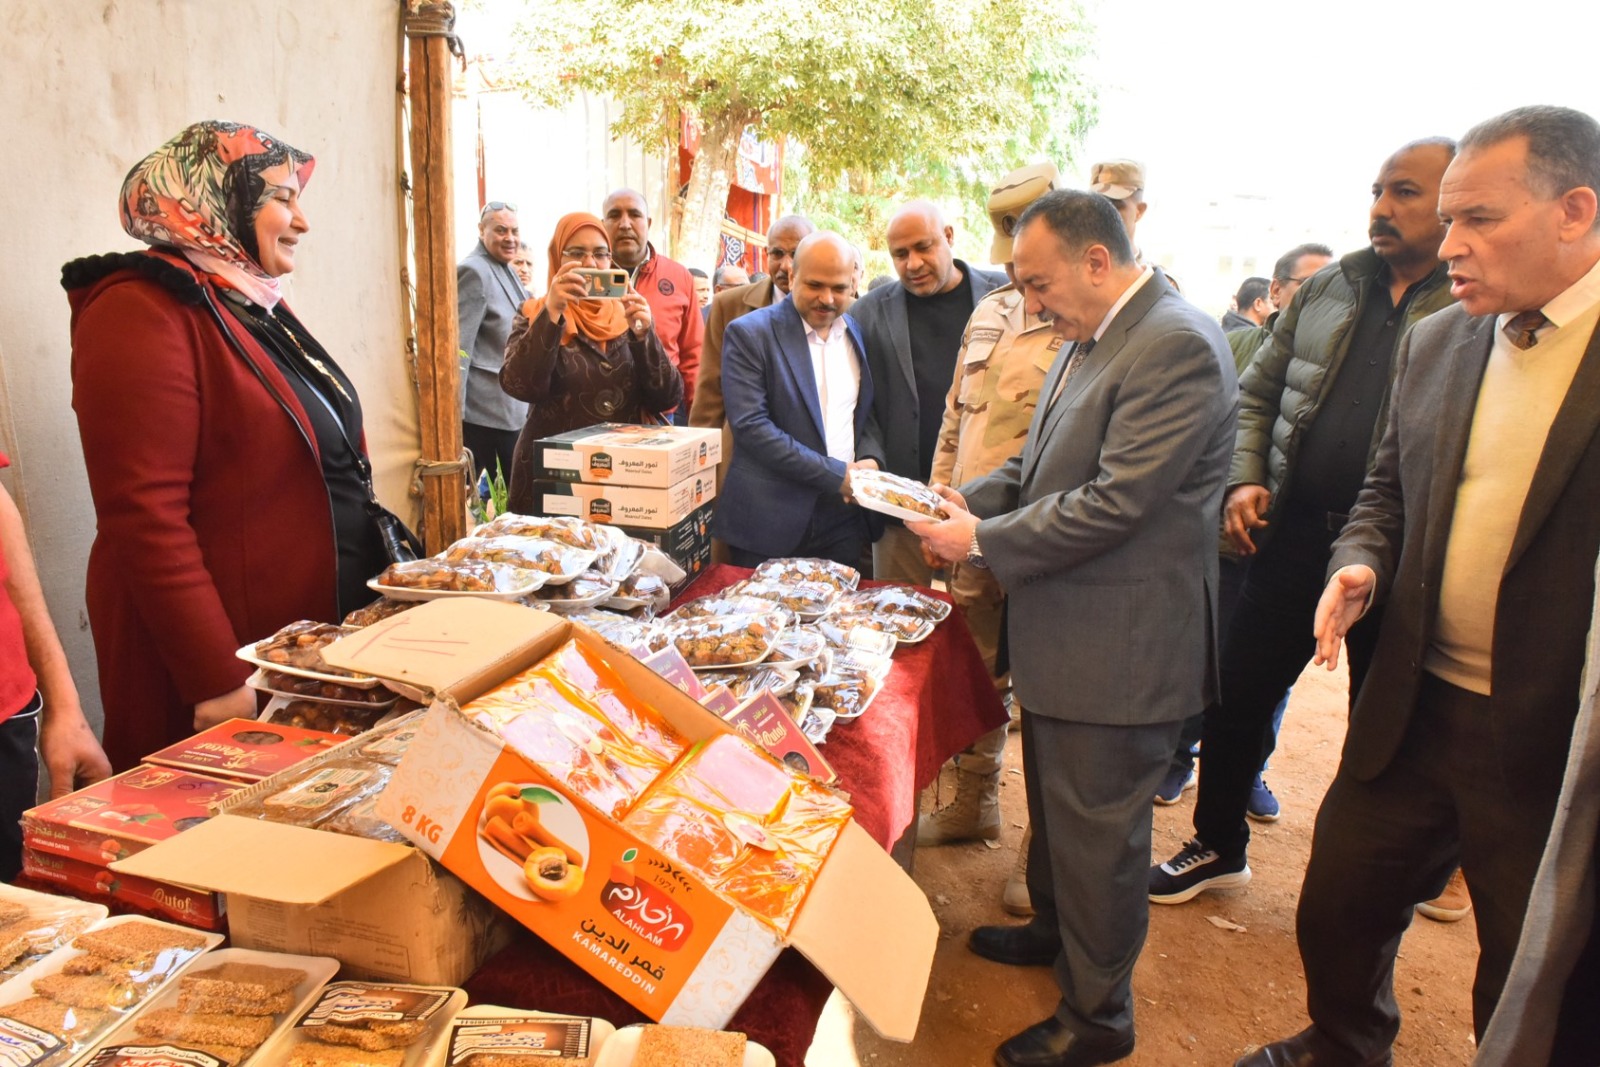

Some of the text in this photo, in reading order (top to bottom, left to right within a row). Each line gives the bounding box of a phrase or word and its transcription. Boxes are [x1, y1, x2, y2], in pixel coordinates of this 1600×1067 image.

[401, 805, 444, 844] 8 KG
[54, 842, 70, 852] DATES
[653, 874, 676, 894] 1974
[612, 908, 664, 947] ALAHLAM
[572, 931, 657, 995] KAMAREDDIN
[580, 918, 666, 981] قمر الدين
